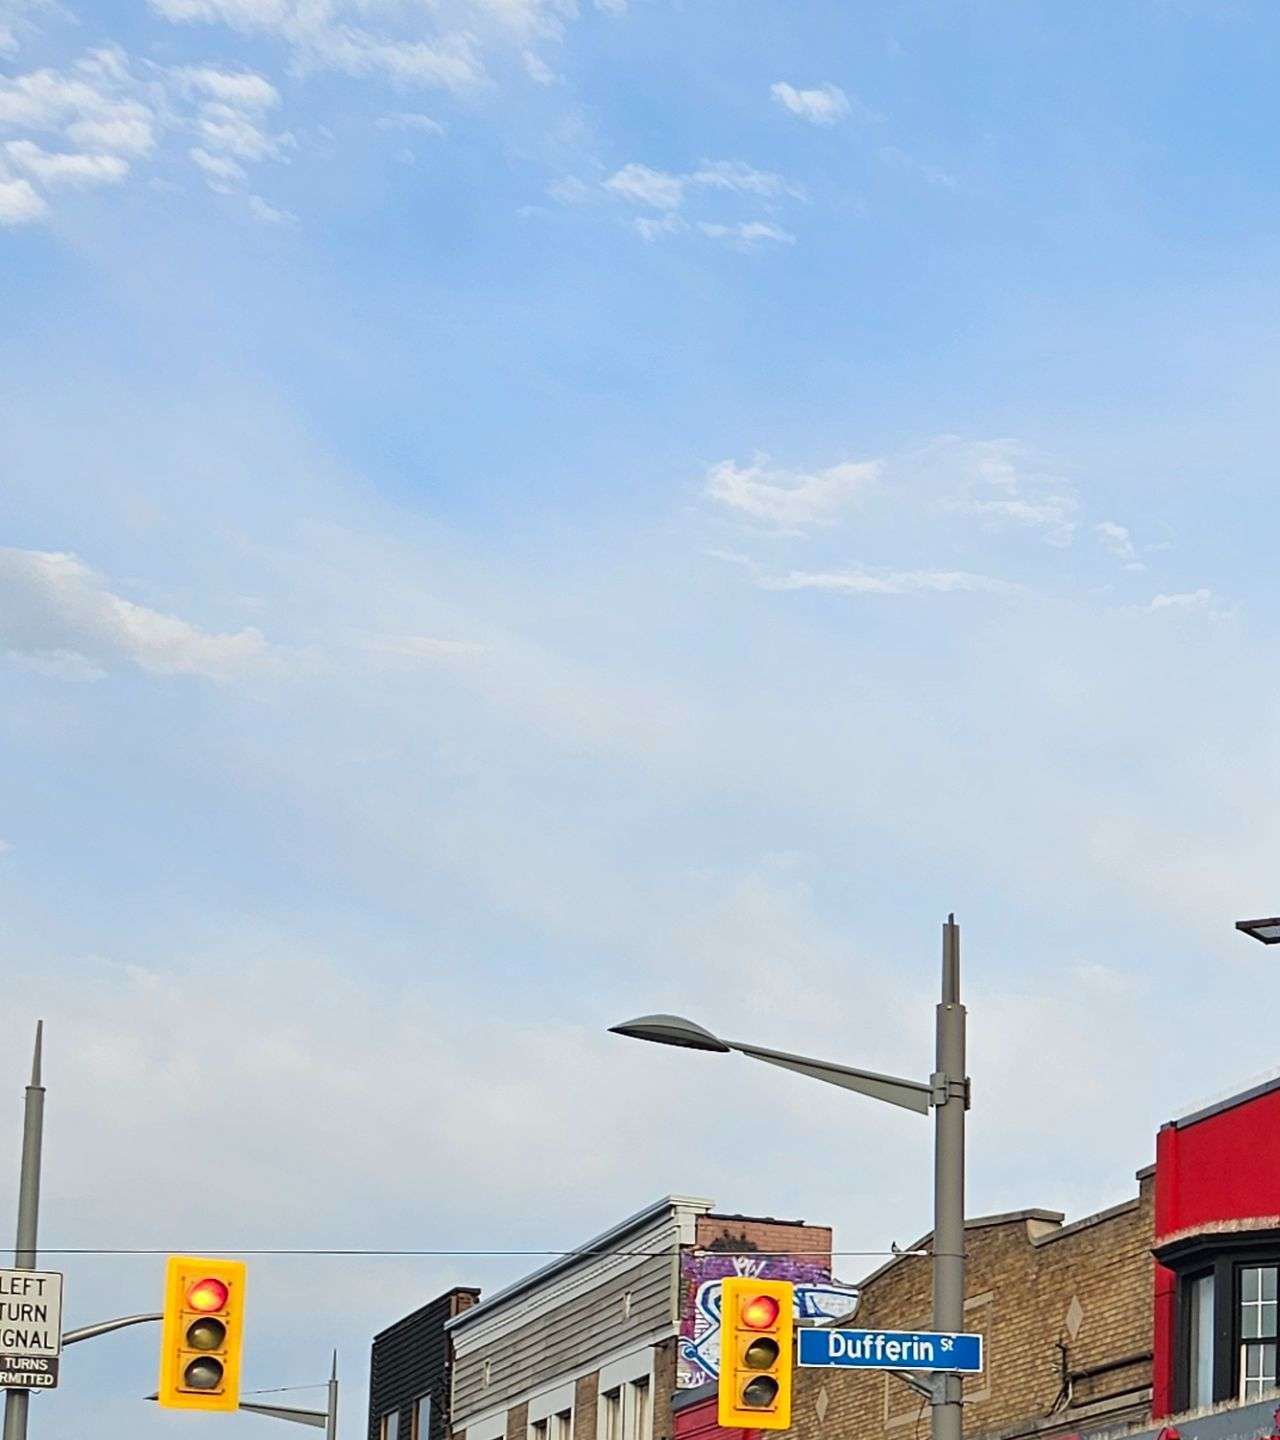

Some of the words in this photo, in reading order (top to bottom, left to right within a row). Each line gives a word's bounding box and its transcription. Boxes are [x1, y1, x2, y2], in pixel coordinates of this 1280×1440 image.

[0, 1277, 46, 1296] LEFT
[828, 1332, 934, 1361] Dufferin
[940, 1337, 954, 1352] St
[4, 1357, 48, 1371] TURNS
[0, 1372, 54, 1385] RMITTED
